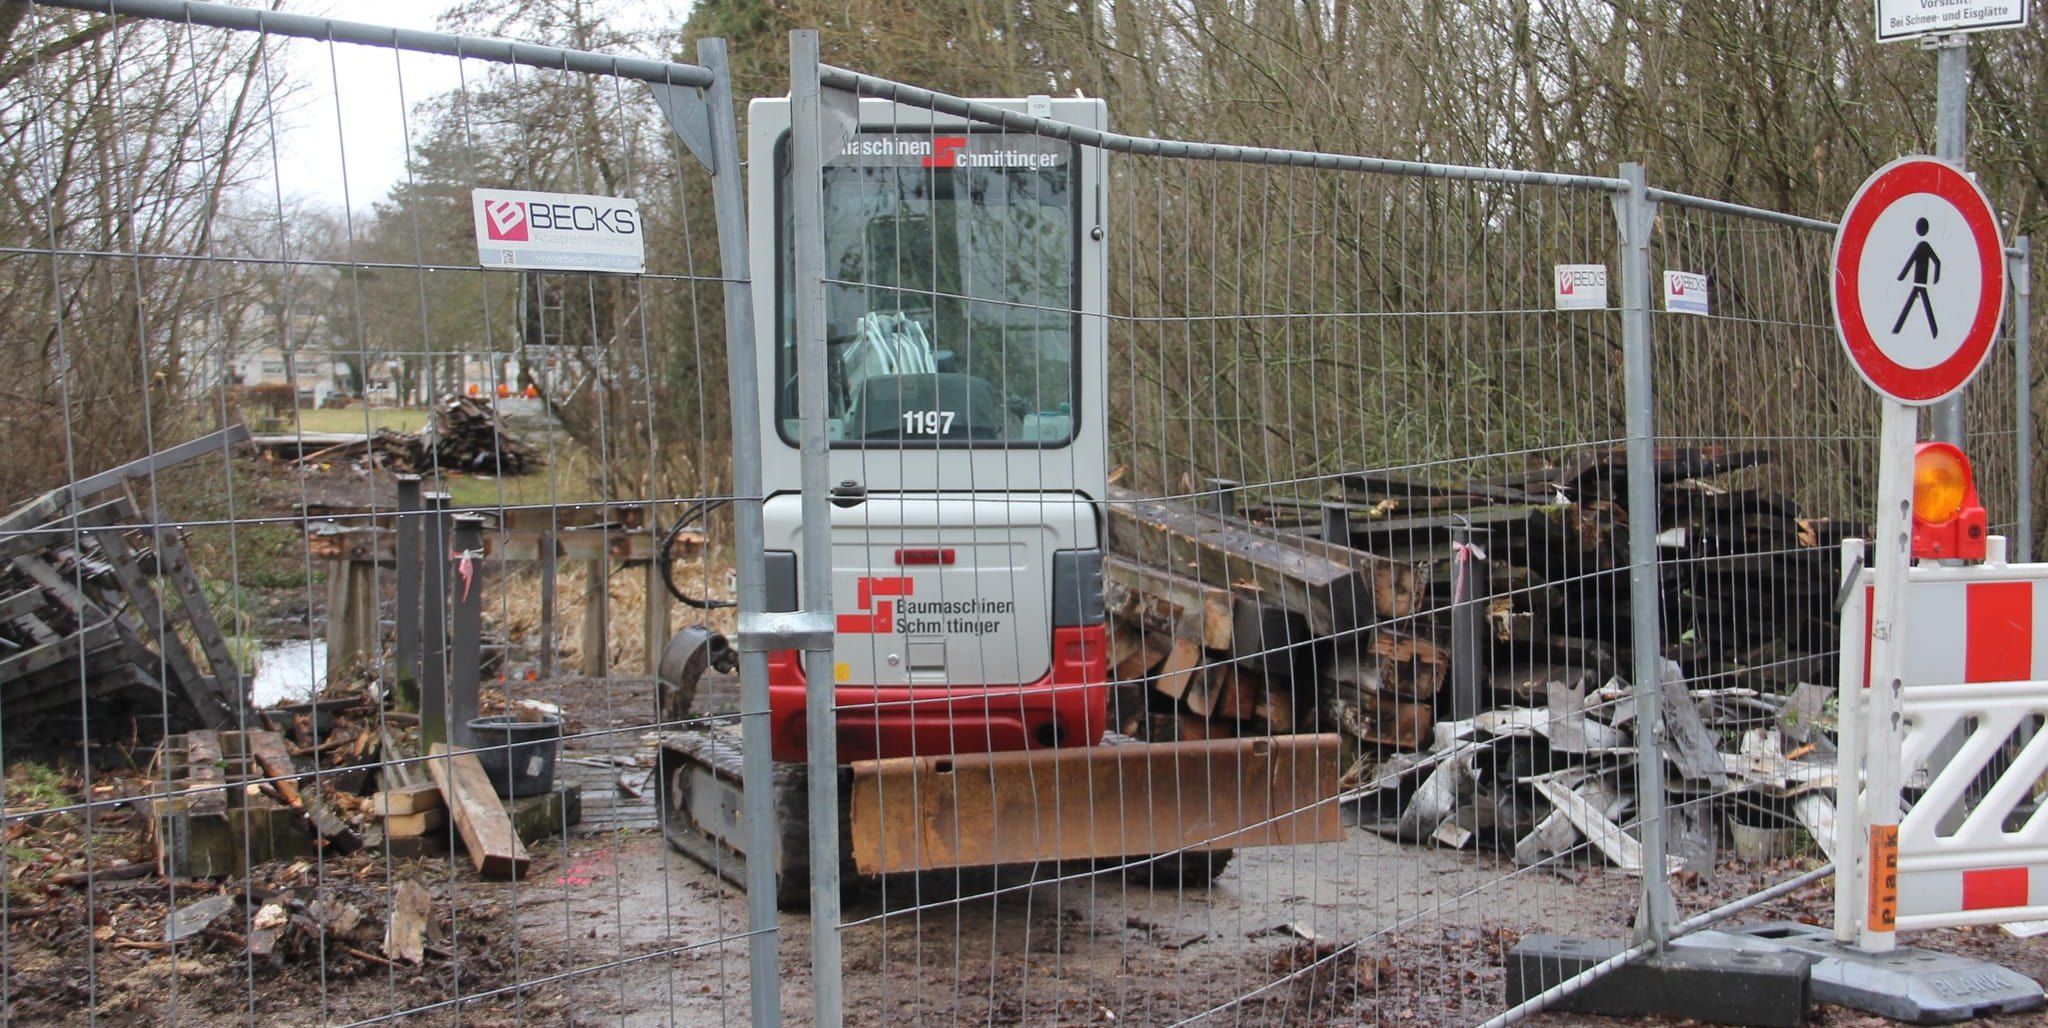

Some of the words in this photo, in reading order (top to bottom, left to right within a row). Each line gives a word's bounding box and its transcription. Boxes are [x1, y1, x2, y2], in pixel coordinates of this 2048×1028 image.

[1920, 0, 1972, 9] Vorsc
[1890, 17, 1904, 29] Bei
[1905, 14, 1940, 26] Schnee-
[1942, 10, 1961, 22] und
[1963, 7, 2009, 21] Eisglätte
[529, 202, 635, 234] BECKS
[1574, 271, 1605, 287] BECKS
[902, 410, 956, 434] 1197
[896, 599, 1014, 614] Baumaschinen
[896, 618, 1000, 636] Schmttinger
[1882, 832, 1898, 925] Plank
[1930, 972, 2012, 998] PLANK
